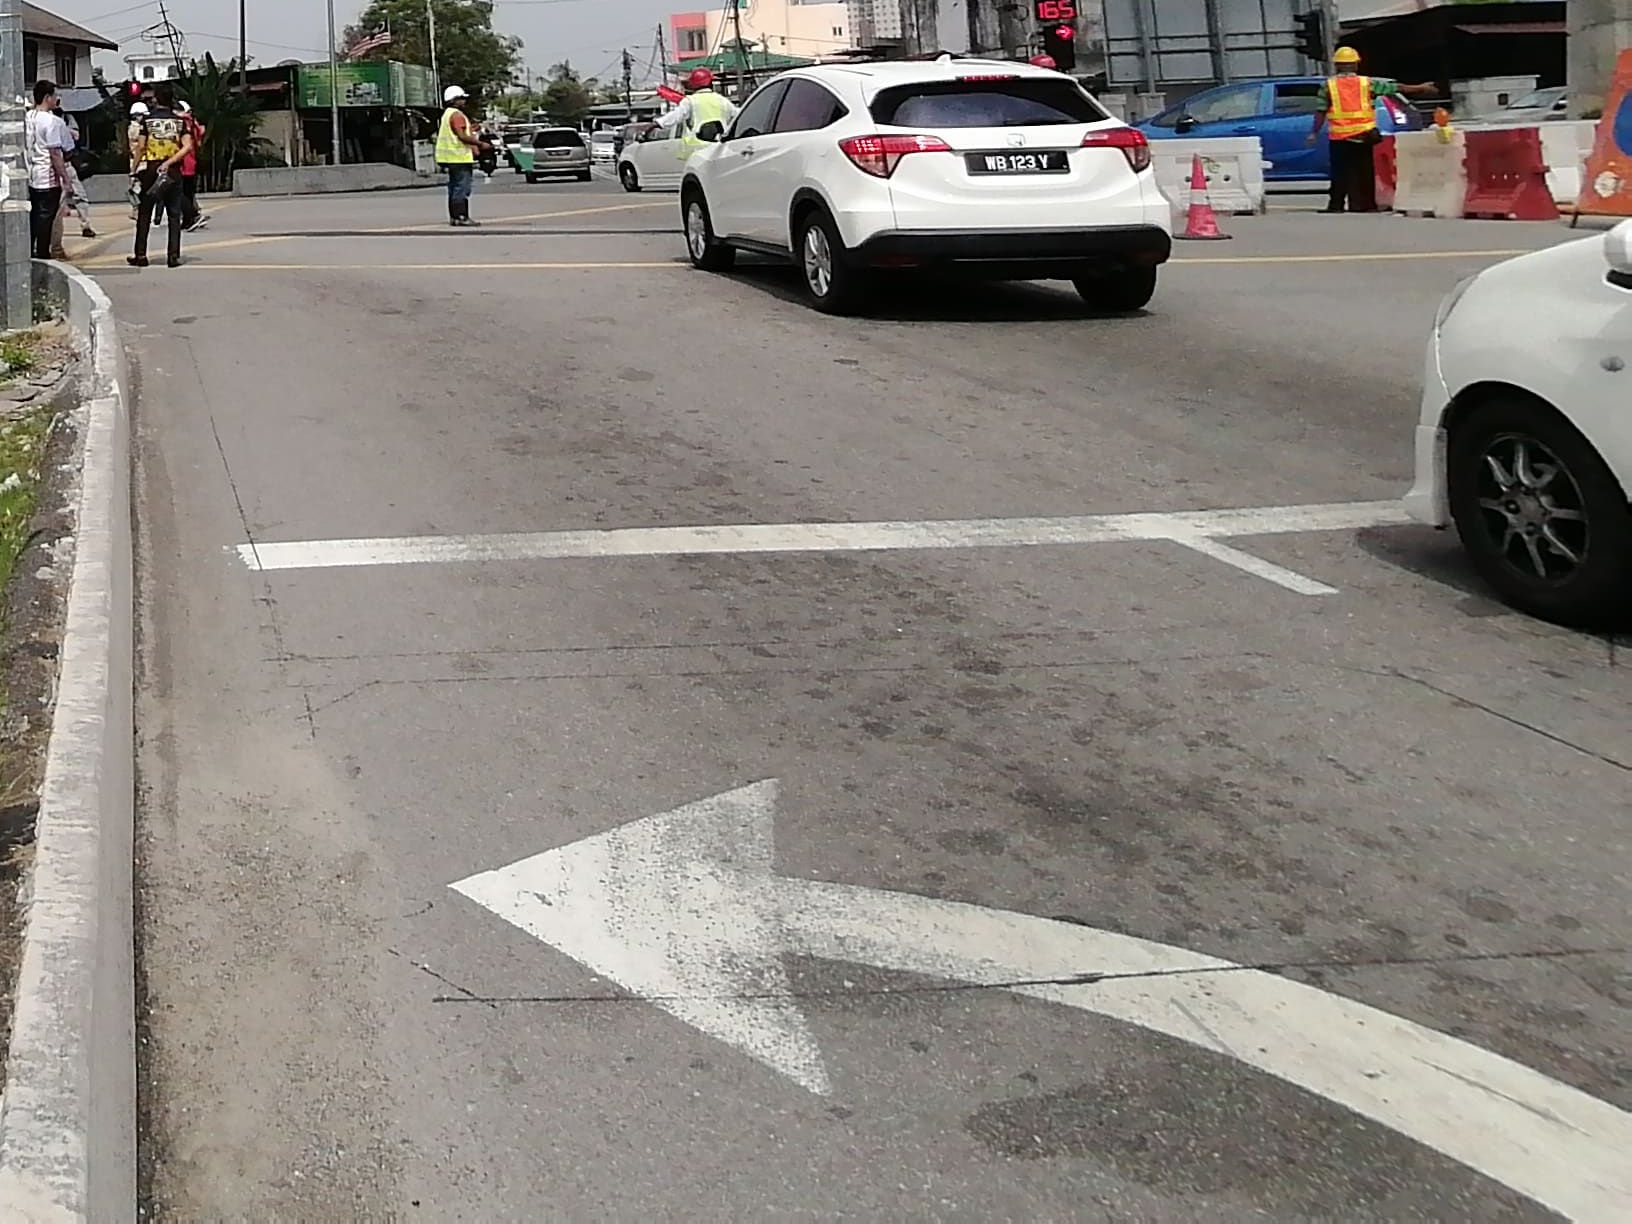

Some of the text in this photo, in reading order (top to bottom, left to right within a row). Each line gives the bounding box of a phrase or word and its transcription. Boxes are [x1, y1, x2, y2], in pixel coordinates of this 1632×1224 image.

[1038, 0, 1074, 19] 165
[984, 153, 1049, 171] WB 123 Y
